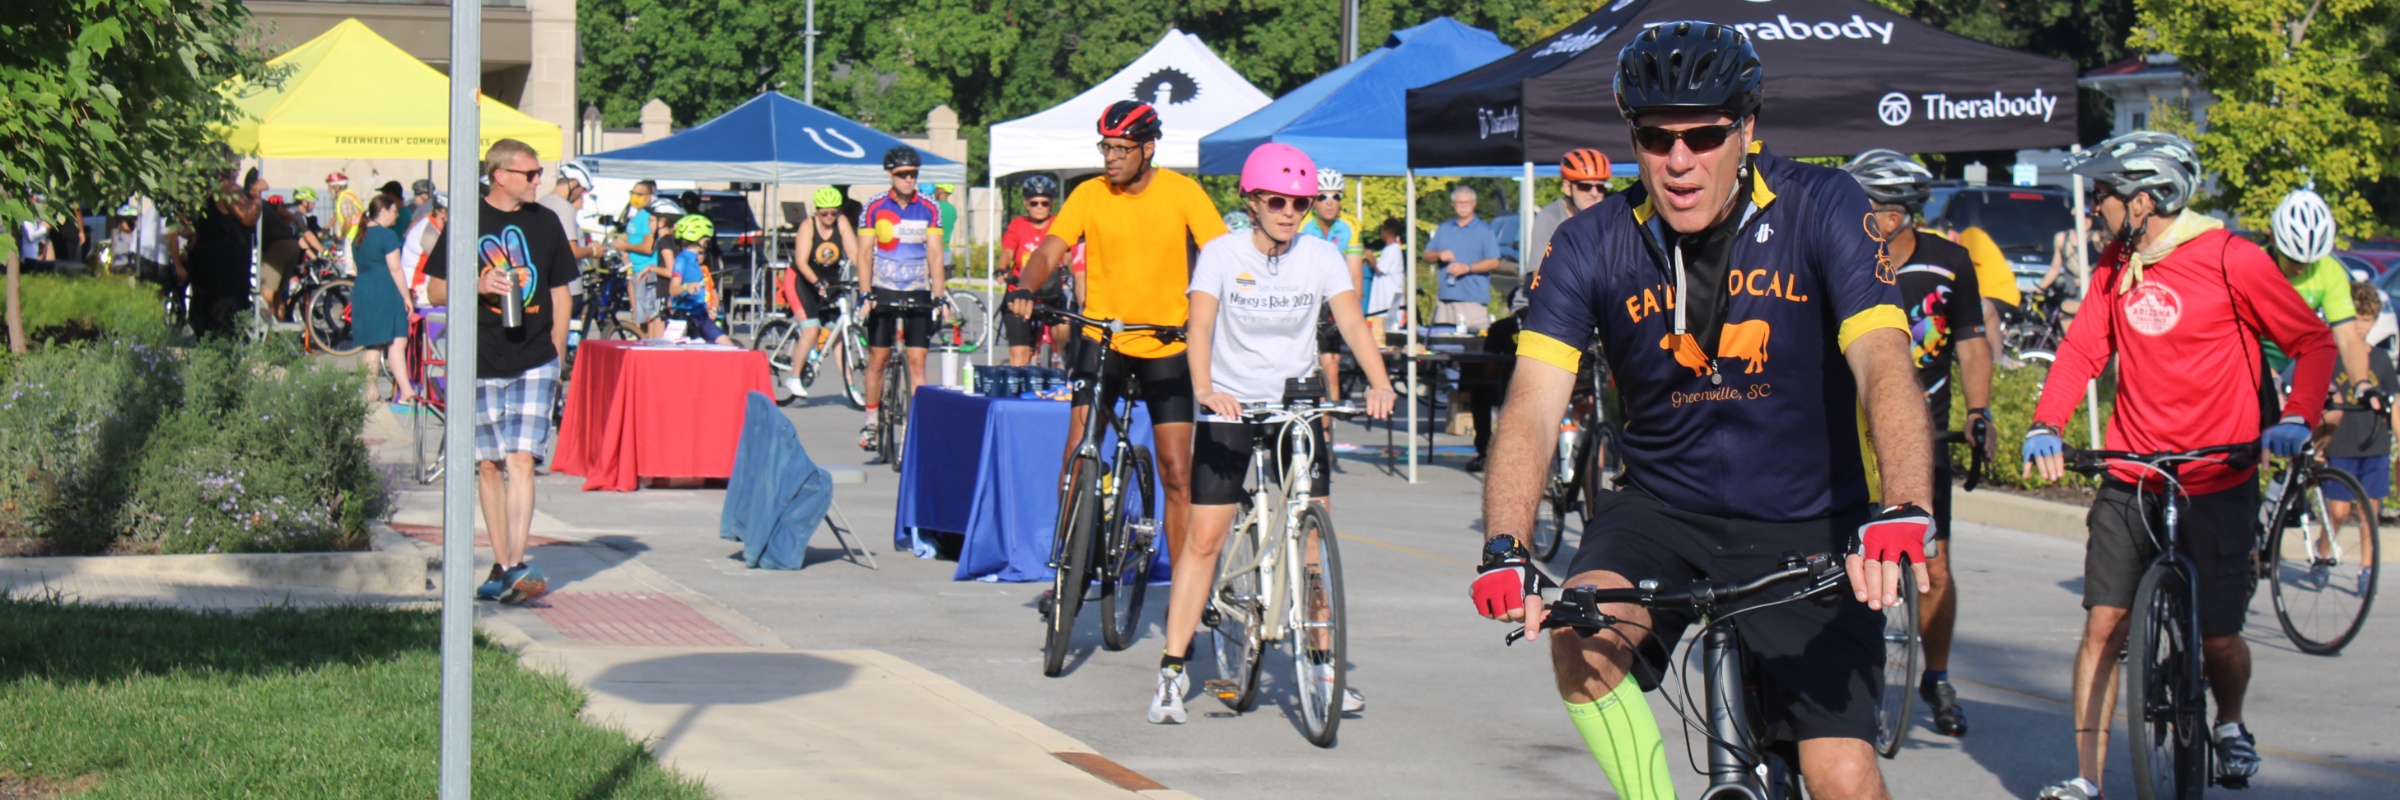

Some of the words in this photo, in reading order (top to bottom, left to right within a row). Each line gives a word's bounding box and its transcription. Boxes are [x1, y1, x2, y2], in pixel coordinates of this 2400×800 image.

[1643, 14, 1894, 45] rabody
[1921, 88, 2057, 123] Therabody
[335, 136, 405, 145] FREEWHEELIN'
[406, 137, 448, 145] COMMUN
[1230, 292, 1267, 307] Nancy's
[1269, 295, 1290, 309] Ride
[1625, 284, 1662, 324] EA
[2133, 308, 2170, 317] ARIZONA
[1671, 386, 1743, 408] Greenville,
[1747, 383, 1773, 400] SC
